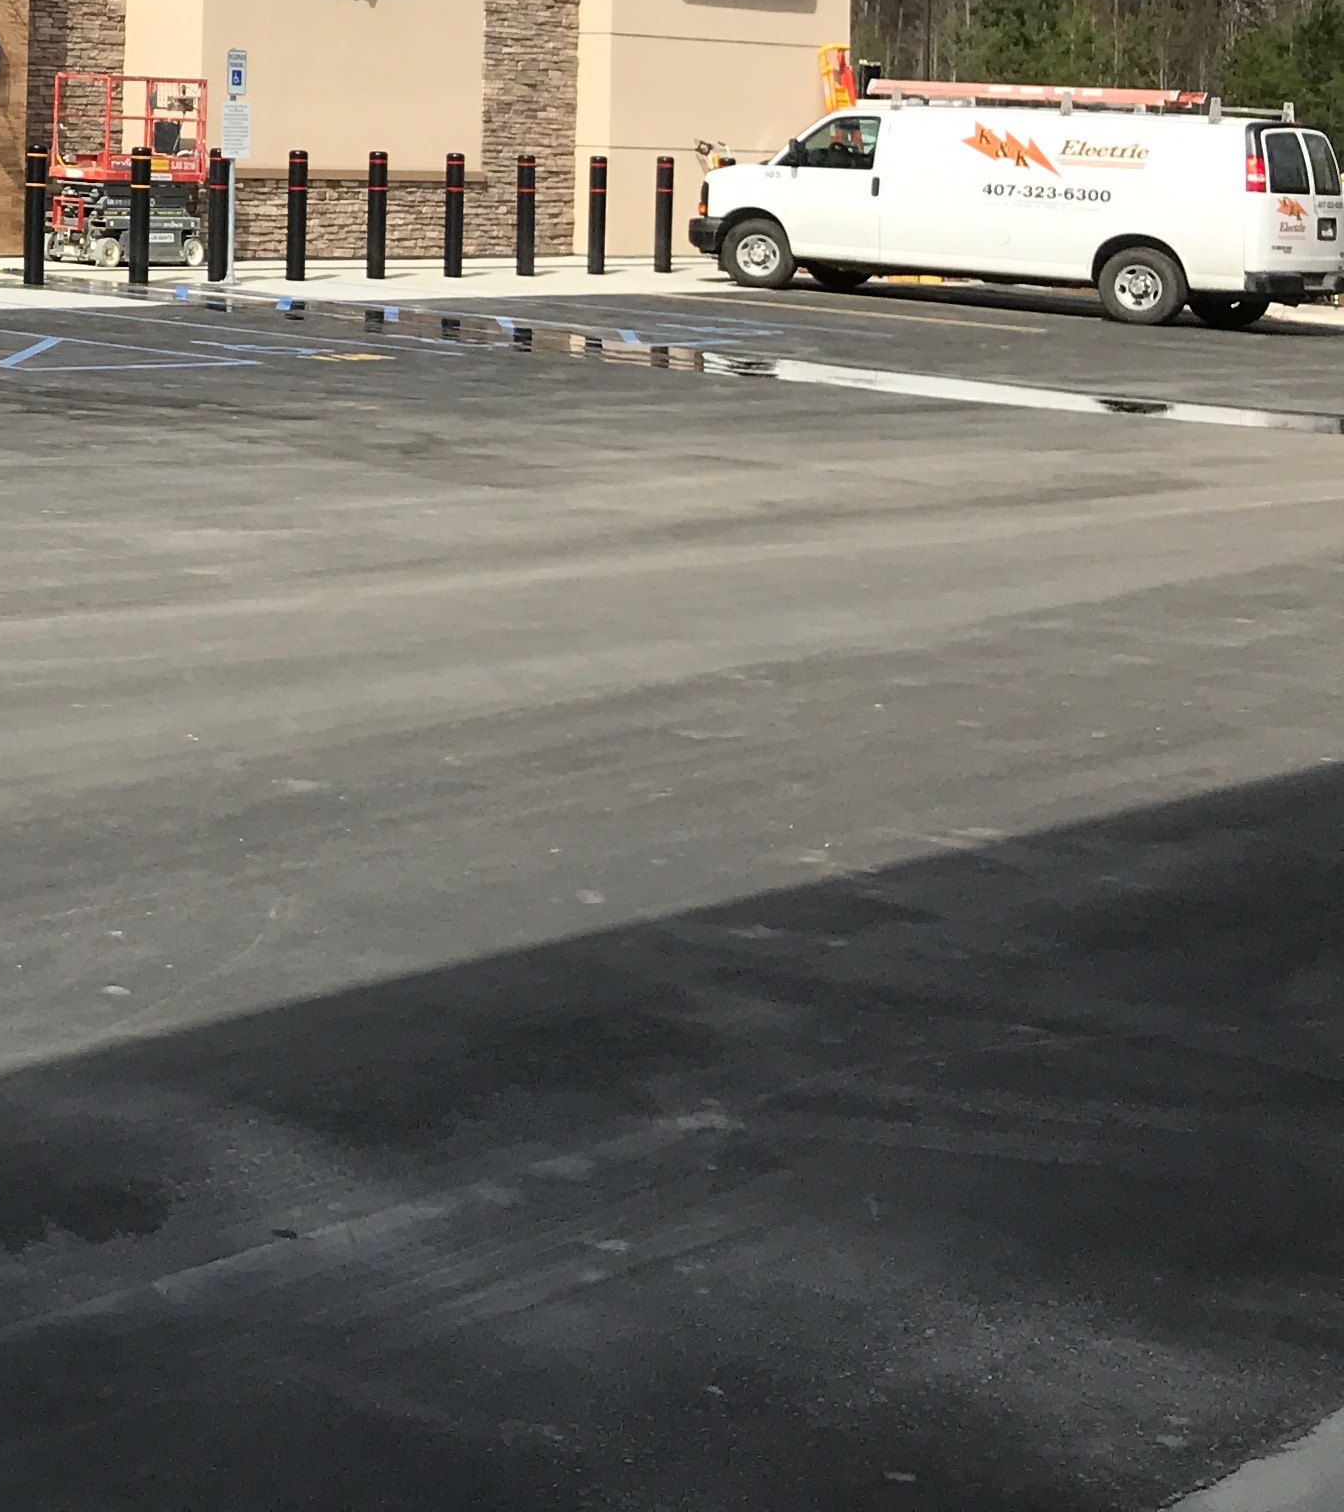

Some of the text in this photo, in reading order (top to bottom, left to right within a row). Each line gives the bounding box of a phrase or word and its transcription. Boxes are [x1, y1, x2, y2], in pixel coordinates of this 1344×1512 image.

[978, 128, 993, 146] K
[1015, 148, 1030, 169] K
[1057, 139, 1150, 160] Electric
[982, 183, 1112, 203] 407-323-6300
